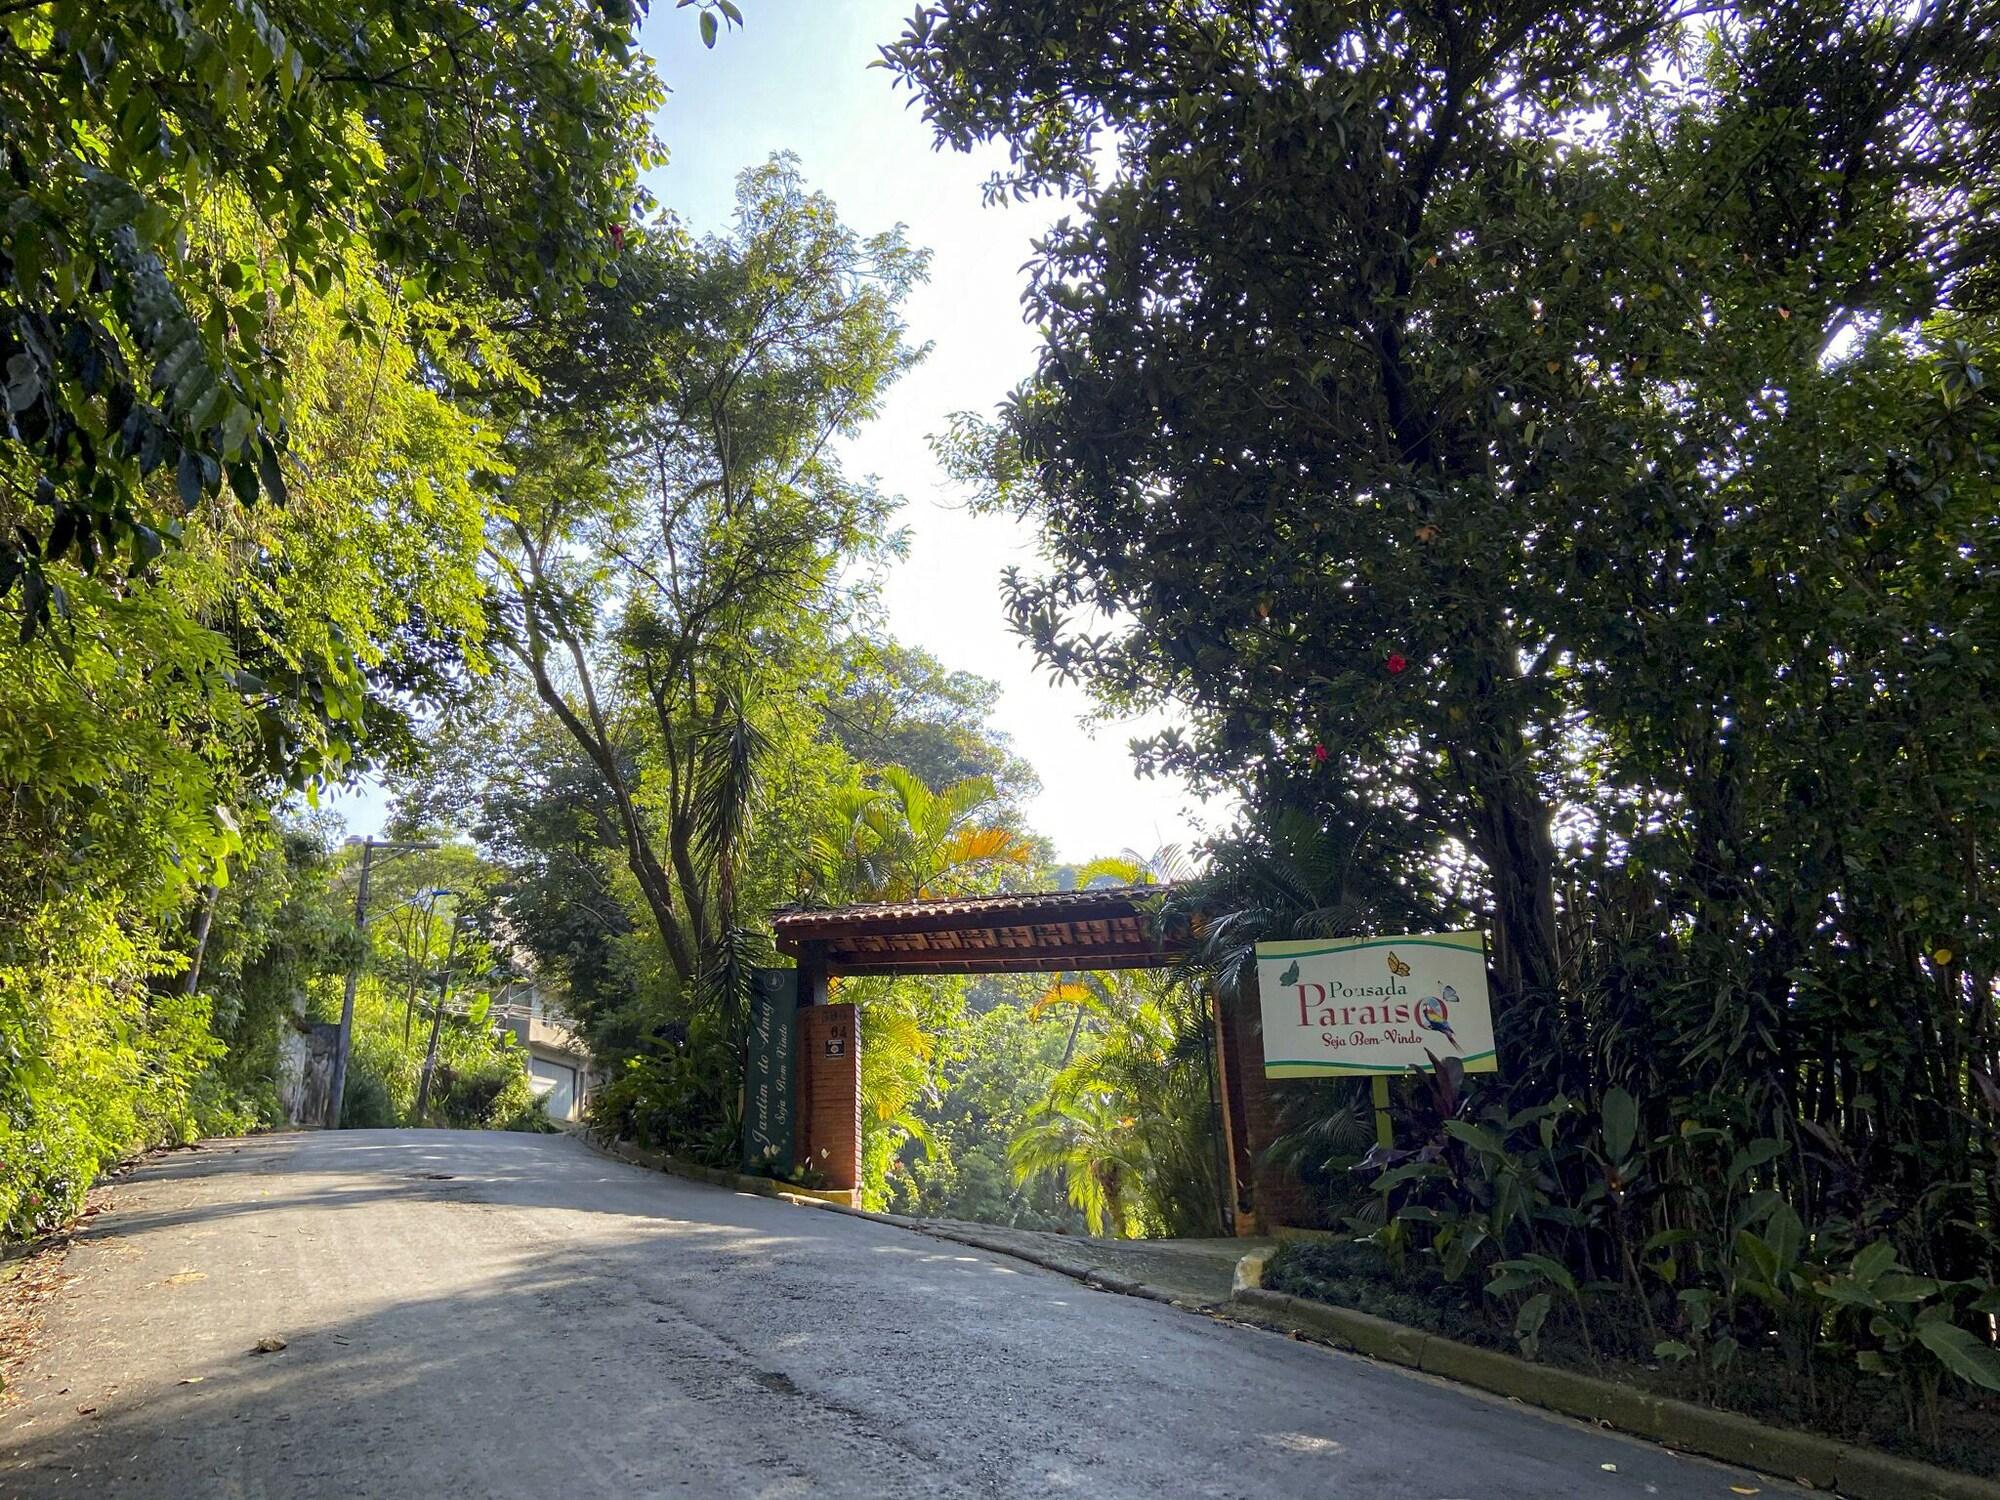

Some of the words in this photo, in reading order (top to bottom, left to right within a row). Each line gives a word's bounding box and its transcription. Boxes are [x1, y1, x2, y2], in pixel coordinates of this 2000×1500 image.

[1329, 976, 1407, 998] Pousada
[1295, 982, 1449, 1031] Paraíso
[776, 1024, 788, 1059] Vindo
[1322, 1032, 1346, 1049] Seja
[1349, 1030, 1422, 1046] Bem-Vindo
[757, 1054, 769, 1074] do
[776, 1065, 787, 1092] Bem
[752, 1084, 771, 1146] Jardim
[774, 1100, 788, 1124] Seja
